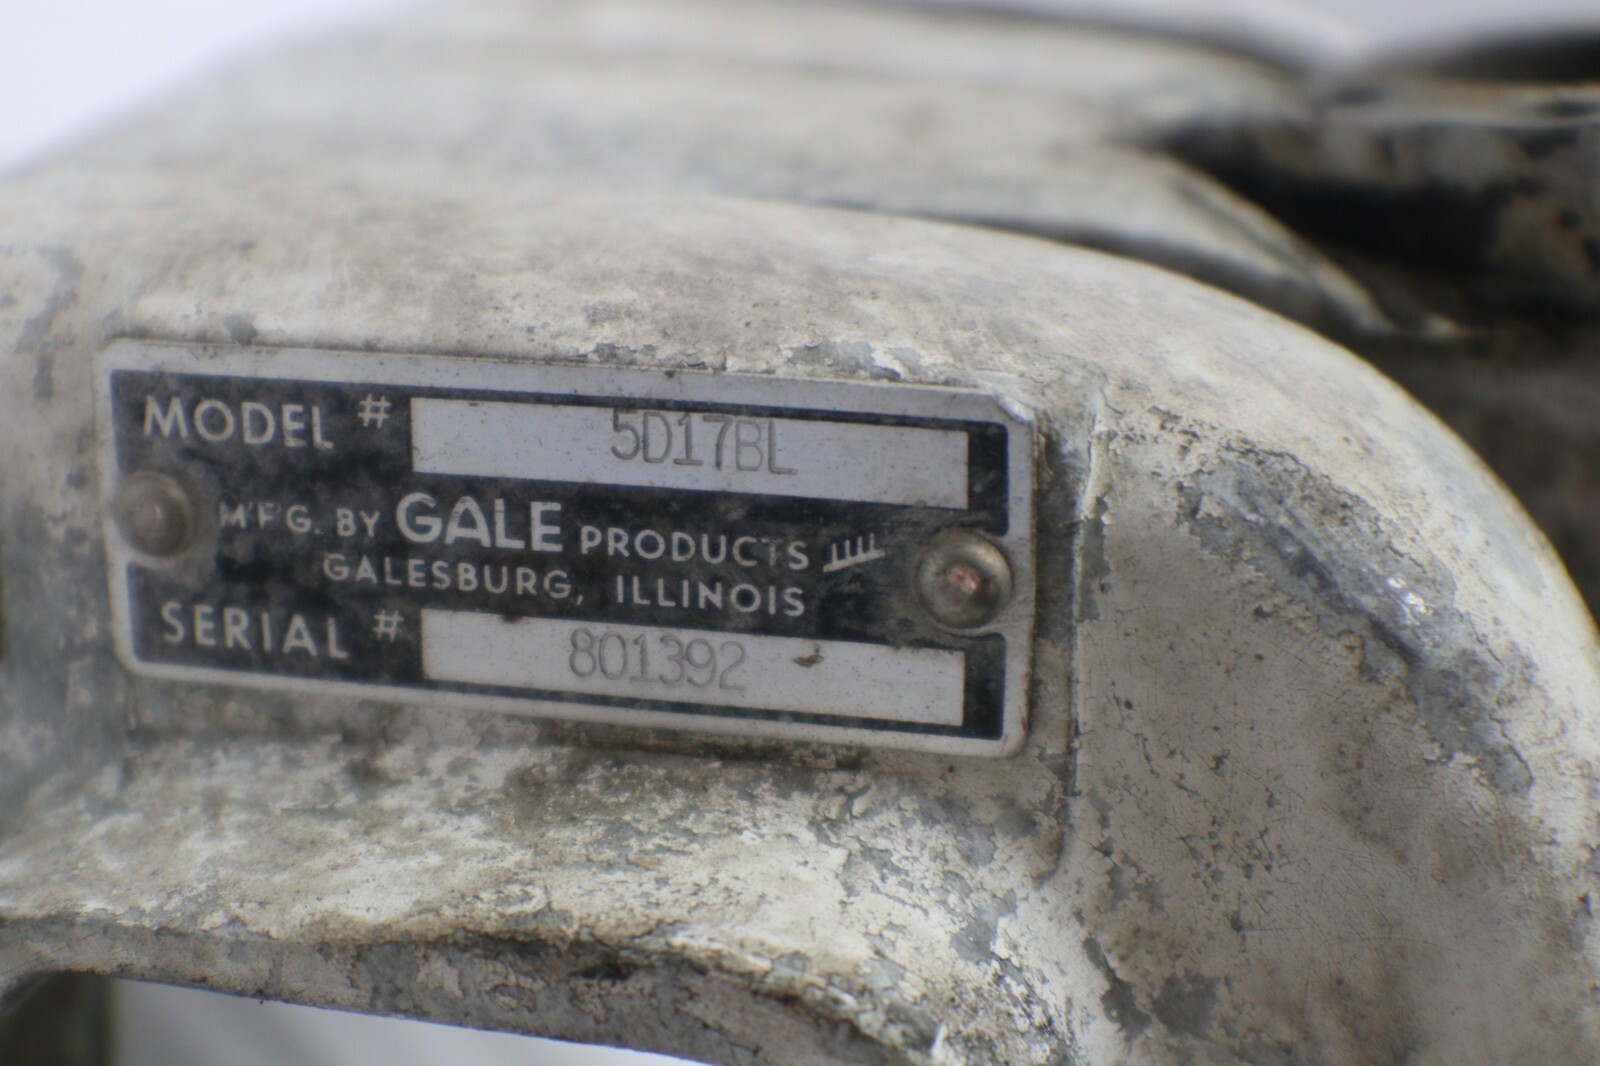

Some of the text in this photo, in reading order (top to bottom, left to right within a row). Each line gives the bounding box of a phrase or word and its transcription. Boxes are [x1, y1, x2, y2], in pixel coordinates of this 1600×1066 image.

[143, 393, 798, 475] MODEL # 5D17BL
[336, 507, 381, 537] BY
[396, 493, 564, 552] GALE
[580, 526, 810, 570] PRODUCTS
[322, 553, 806, 617] GALESBURG, ILLINOIS
[160, 601, 747, 692] SERIAL # 801392
